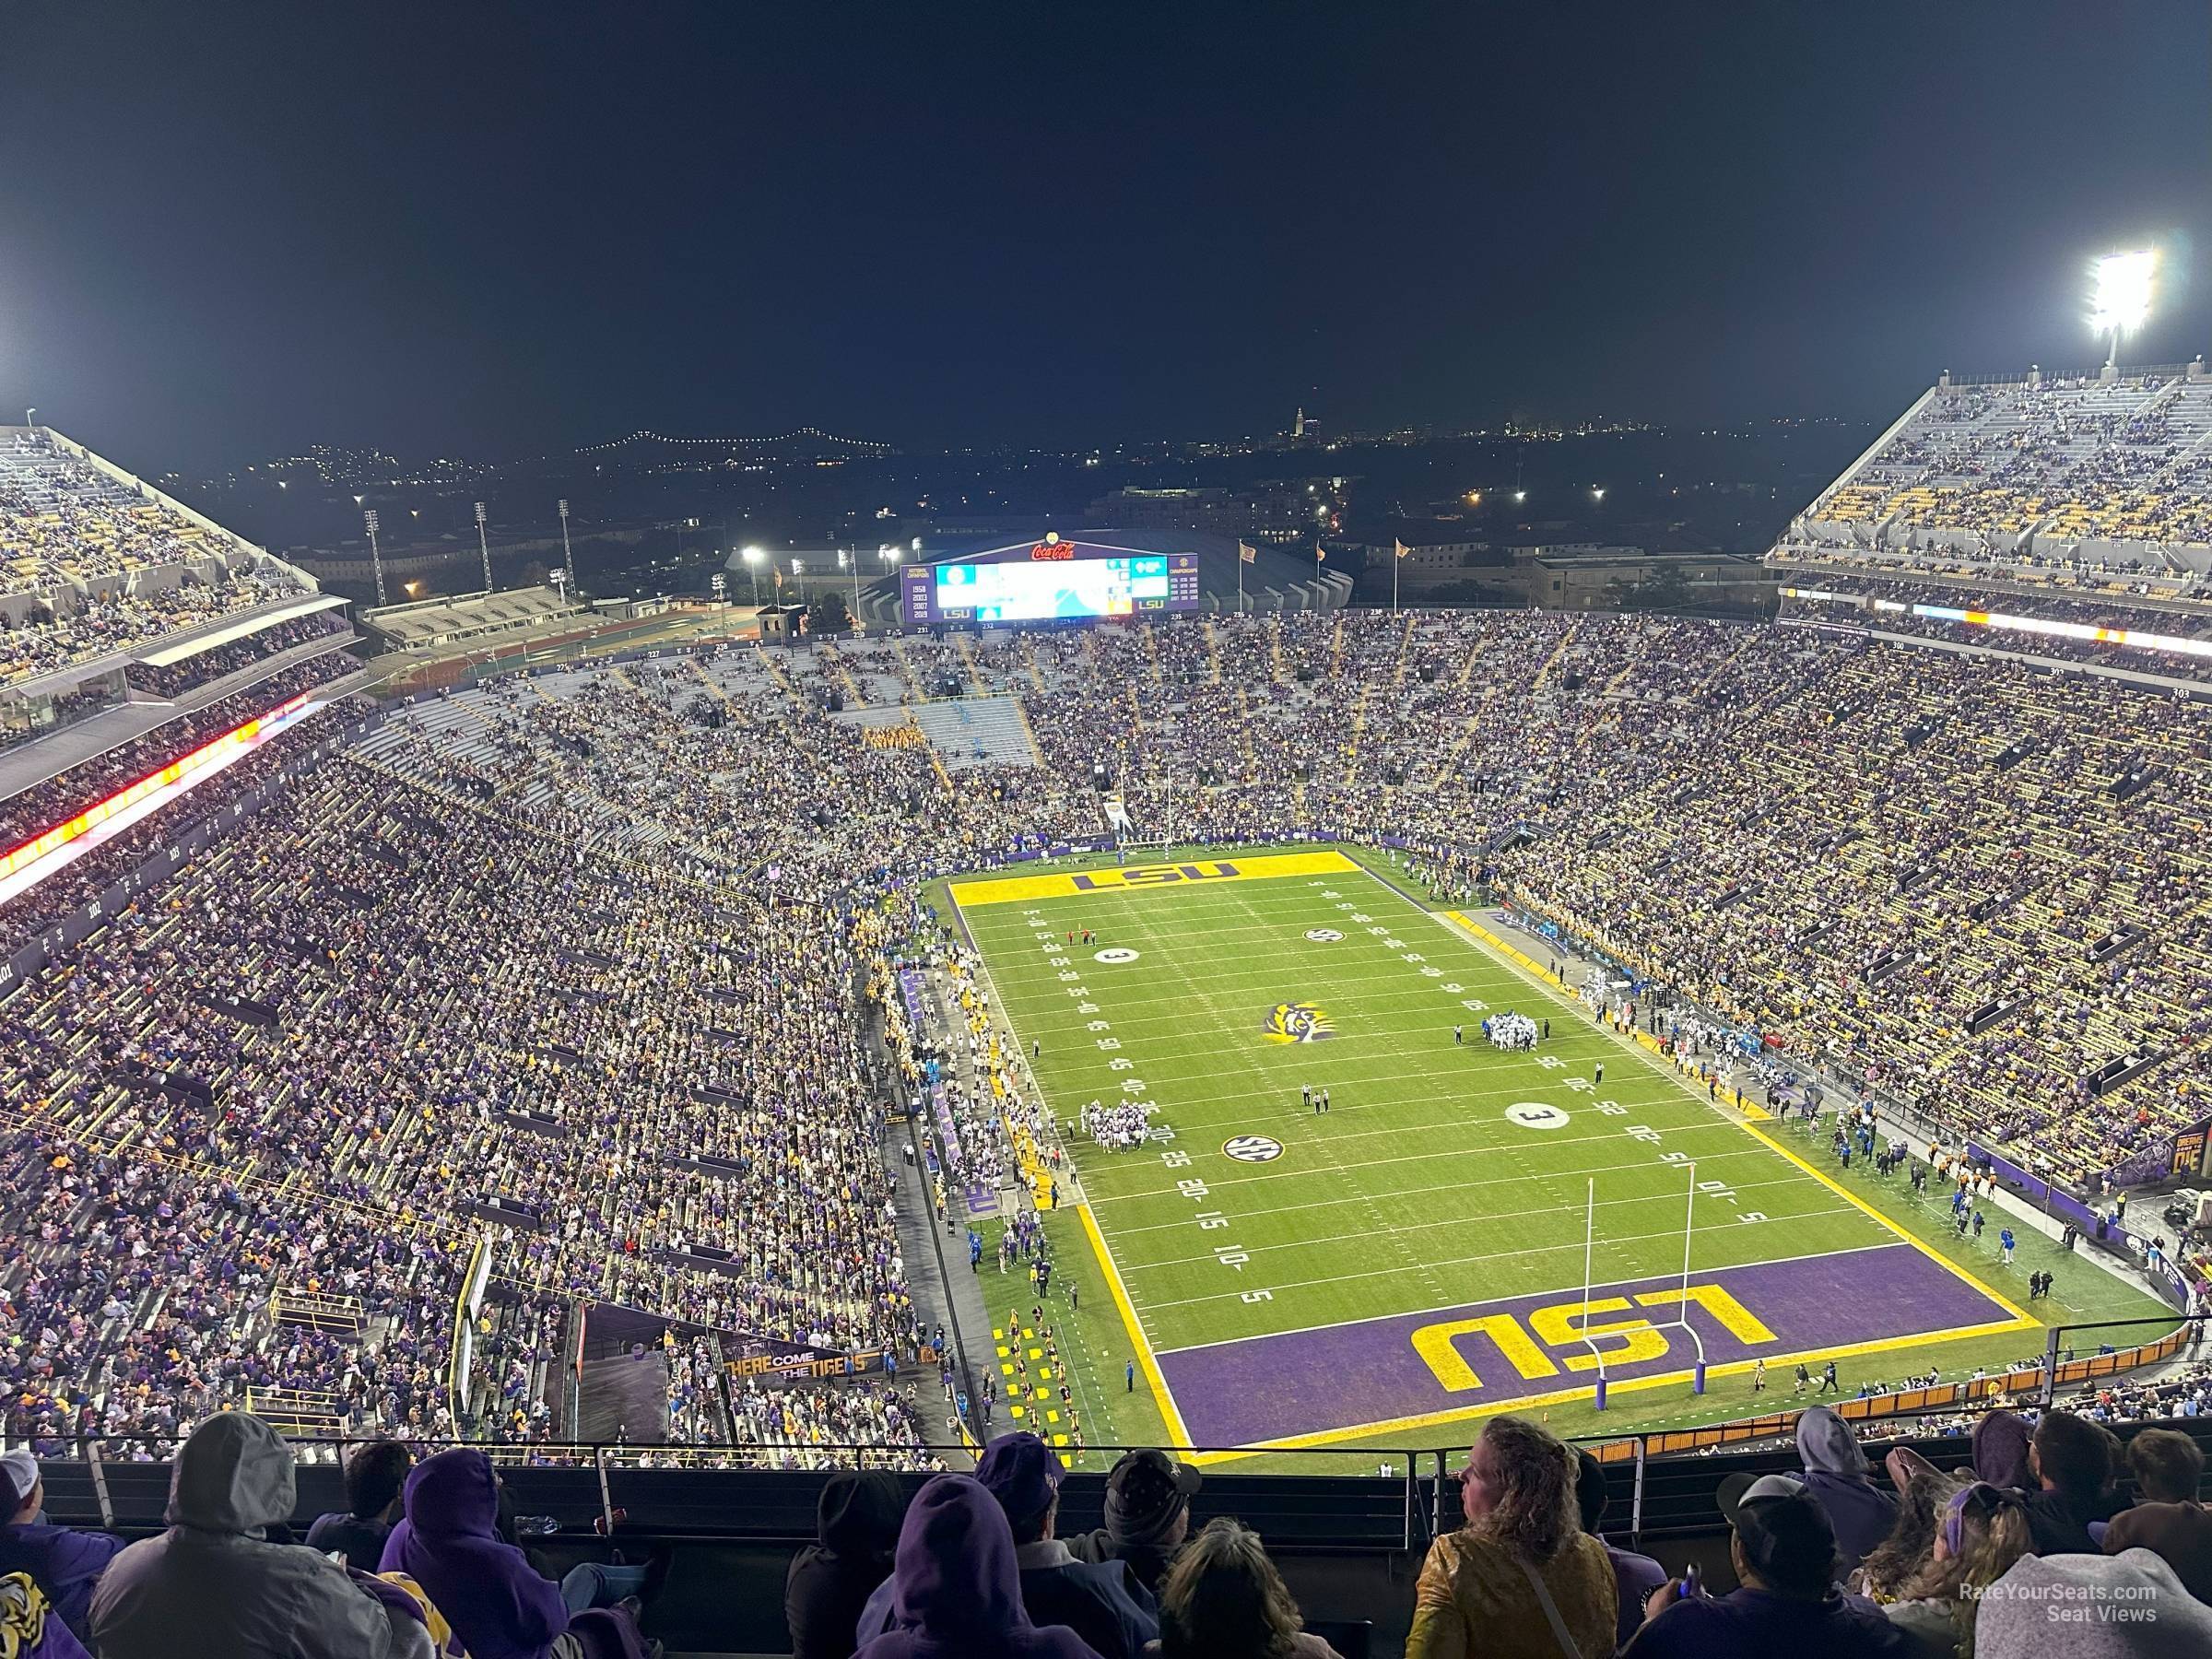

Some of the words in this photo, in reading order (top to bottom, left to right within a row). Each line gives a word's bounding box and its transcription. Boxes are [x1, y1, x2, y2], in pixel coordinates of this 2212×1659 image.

[912, 602, 928, 610] 2007
[1139, 600, 1164, 610] LSU
[943, 608, 971, 619] LSU
[648, 650, 660, 658] 227
[2173, 688, 2190, 700] 303
[170, 846, 181, 862] 103
[1071, 863, 1241, 891] LSU
[88, 900, 102, 920] 102
[1460, 999, 1489, 1011] 50
[1096, 1038, 1121, 1051] 50
[1108, 1057, 1134, 1070] 45
[1534, 1055, 1567, 1069] 35
[1120, 1078, 1146, 1092] 40
[1562, 1077, 1596, 1092] 30
[1592, 1100, 1629, 1115] 25
[1518, 1110, 1555, 1121] 3
[1146, 1124, 1175, 1141] 30
[1624, 1124, 1662, 1142] 20
[1225, 1135, 1281, 1162] SEC
[2176, 1135, 2204, 1147] DREAMS
[1160, 1149, 1193, 1169] 25
[1658, 1151, 1697, 1169] 15
[2173, 1148, 2201, 1174] DIE
[1176, 1178, 1209, 1197] 20
[1696, 1181, 1736, 1198] 10
[1194, 1210, 1229, 1230] 15
[1735, 1211, 1768, 1223] 5
[1214, 1244, 1250, 1265] 10
[1241, 1290, 1274, 1304] 5
[1410, 1284, 1779, 1392] LSU
[772, 1352, 815, 1368] COME
[781, 1366, 809, 1379] THE
